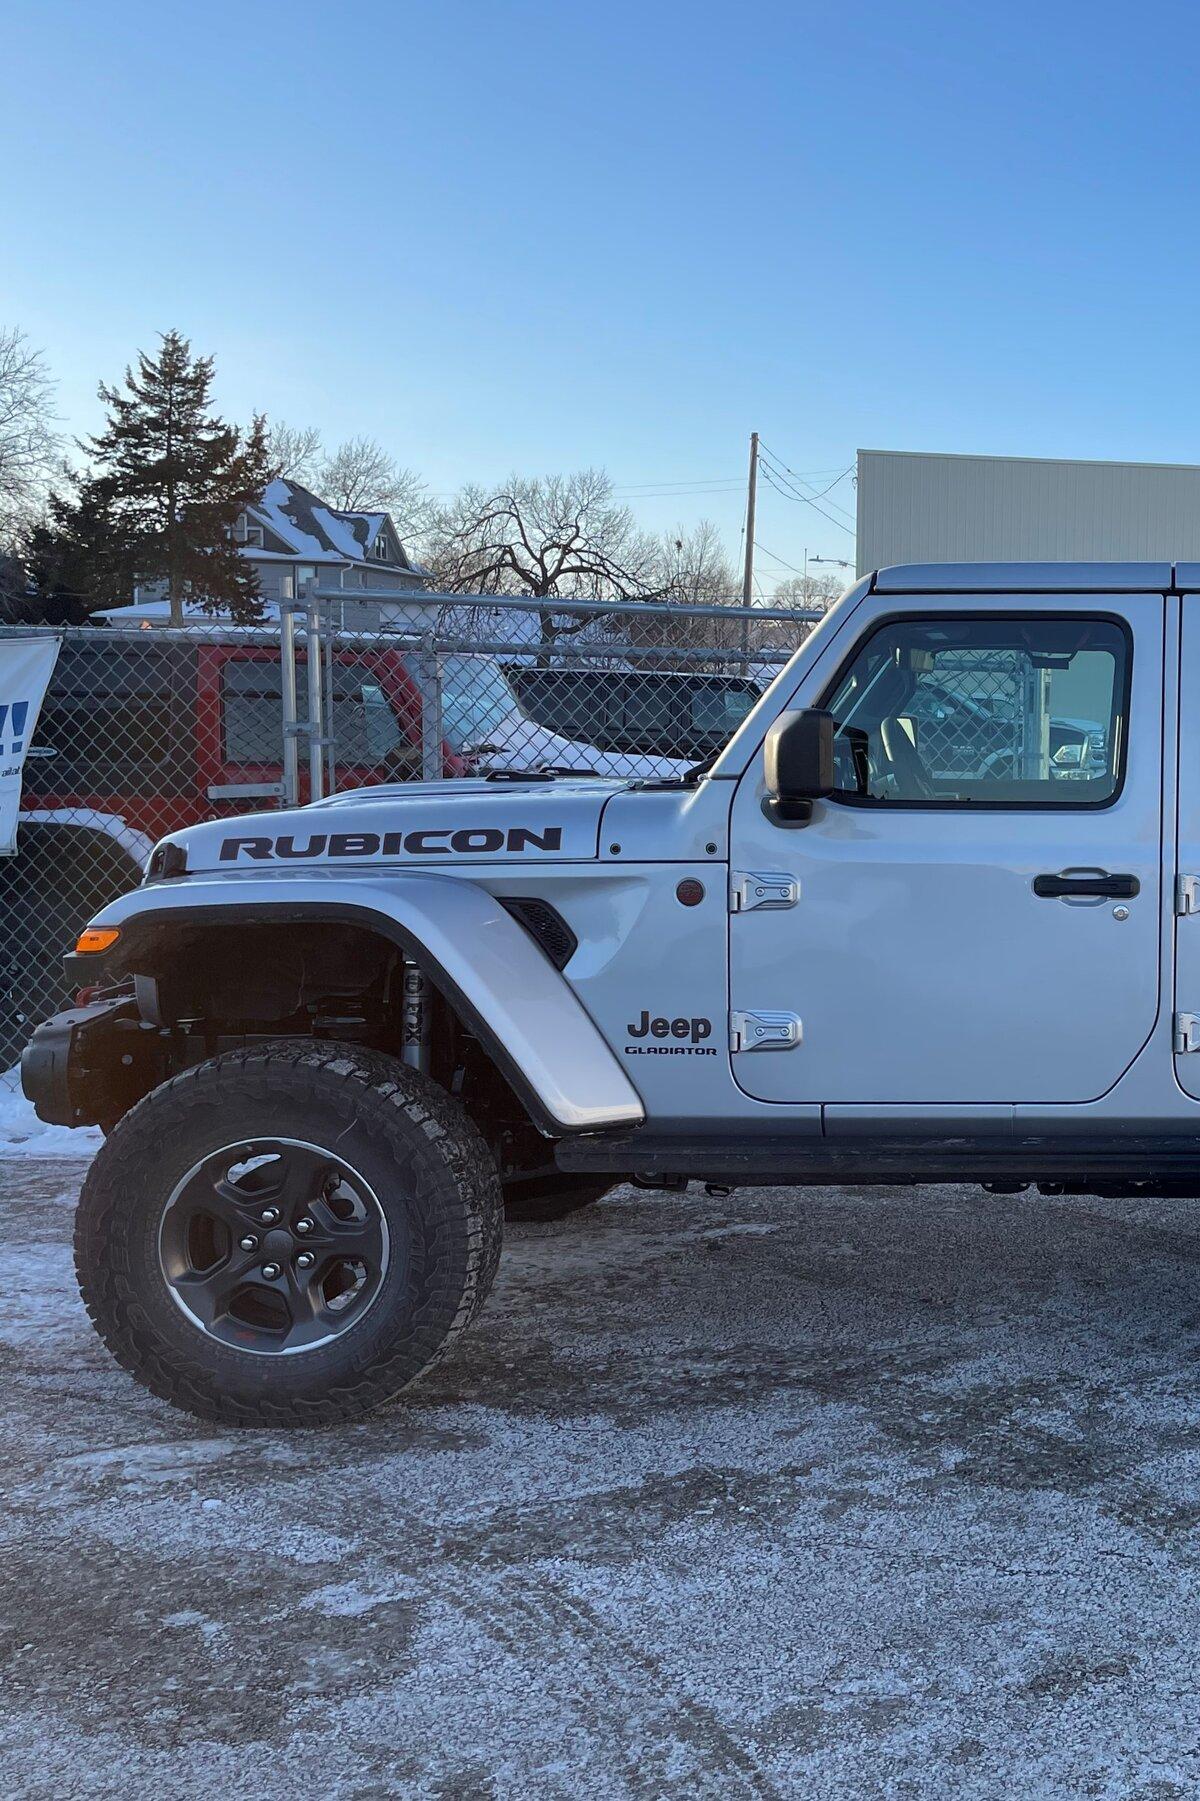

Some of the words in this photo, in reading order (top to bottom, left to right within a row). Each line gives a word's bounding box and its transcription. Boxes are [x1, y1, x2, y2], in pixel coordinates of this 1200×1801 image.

[219, 827, 562, 861] RUBICON
[627, 1010, 712, 1043] Jeep
[624, 1046, 718, 1056] GLADIATOR
